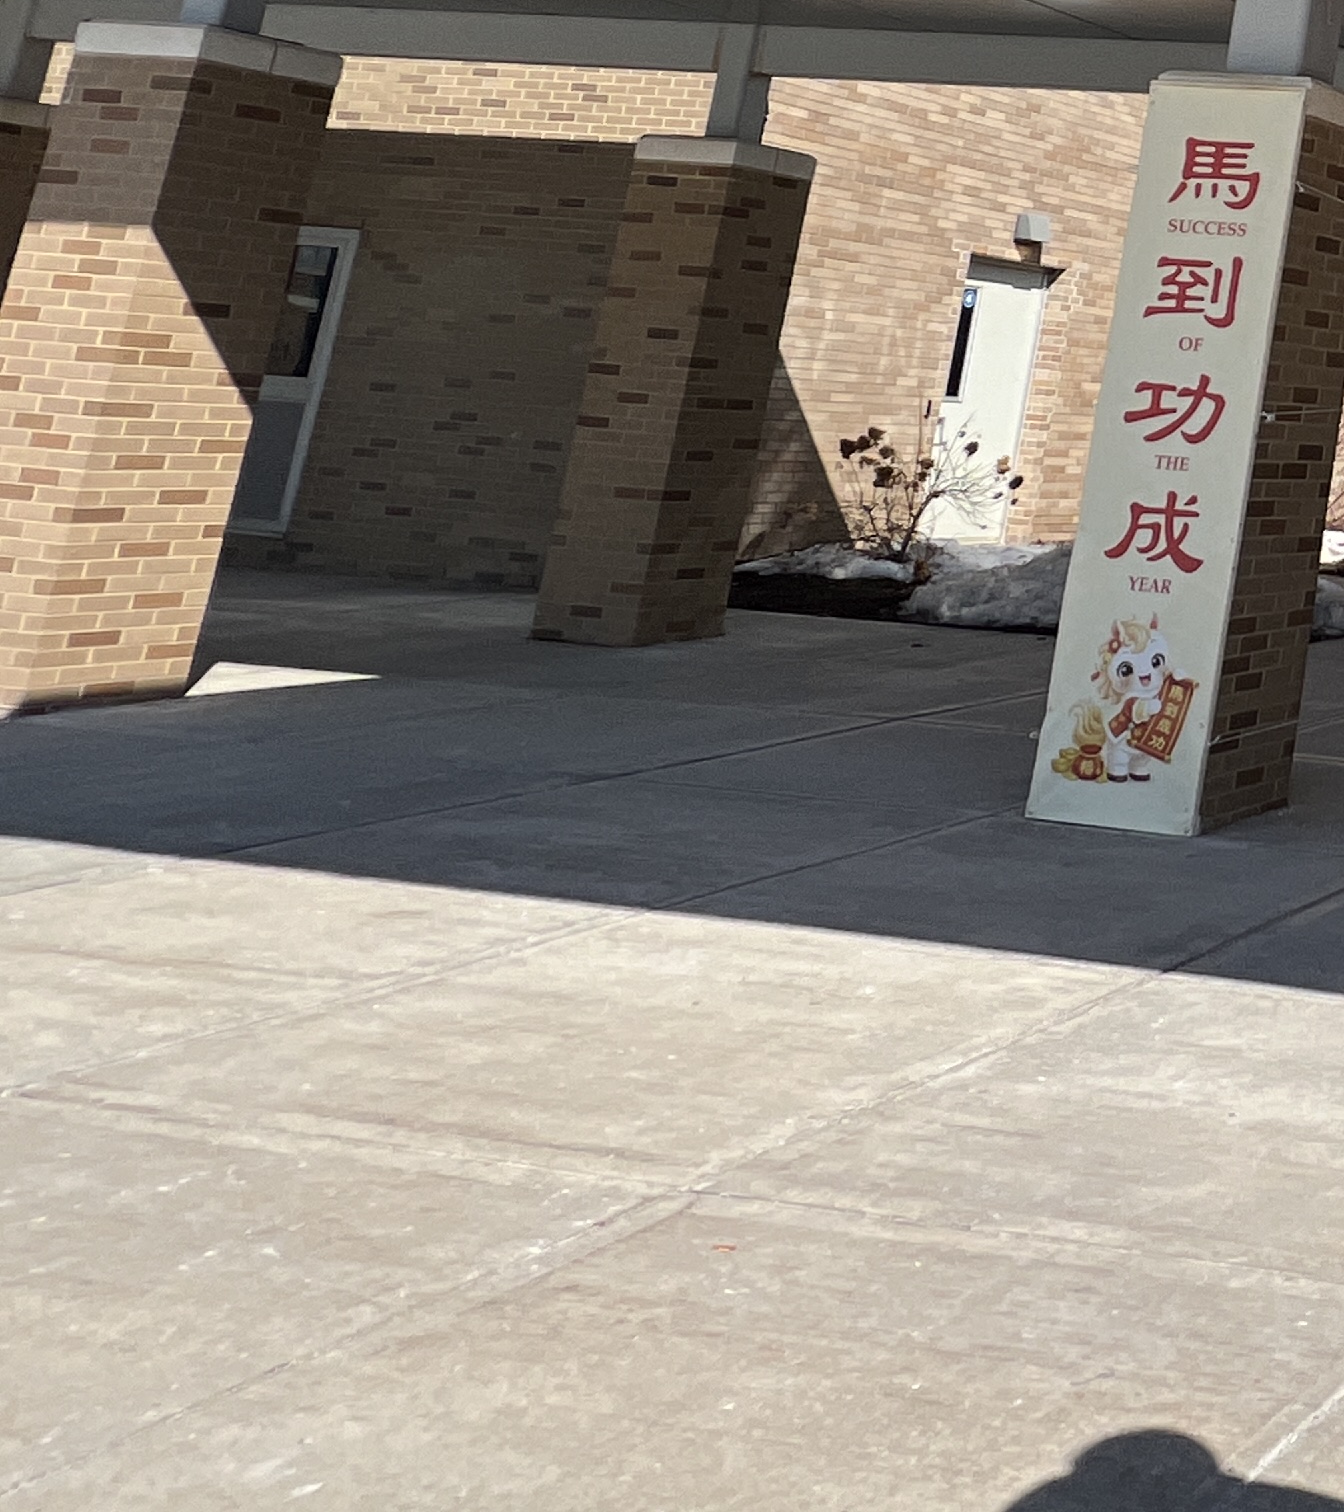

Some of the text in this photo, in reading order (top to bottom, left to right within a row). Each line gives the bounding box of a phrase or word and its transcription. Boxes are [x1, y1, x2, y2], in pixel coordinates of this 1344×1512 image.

[1128, 218, 1248, 595] SUCCESS OF THE YEAR
